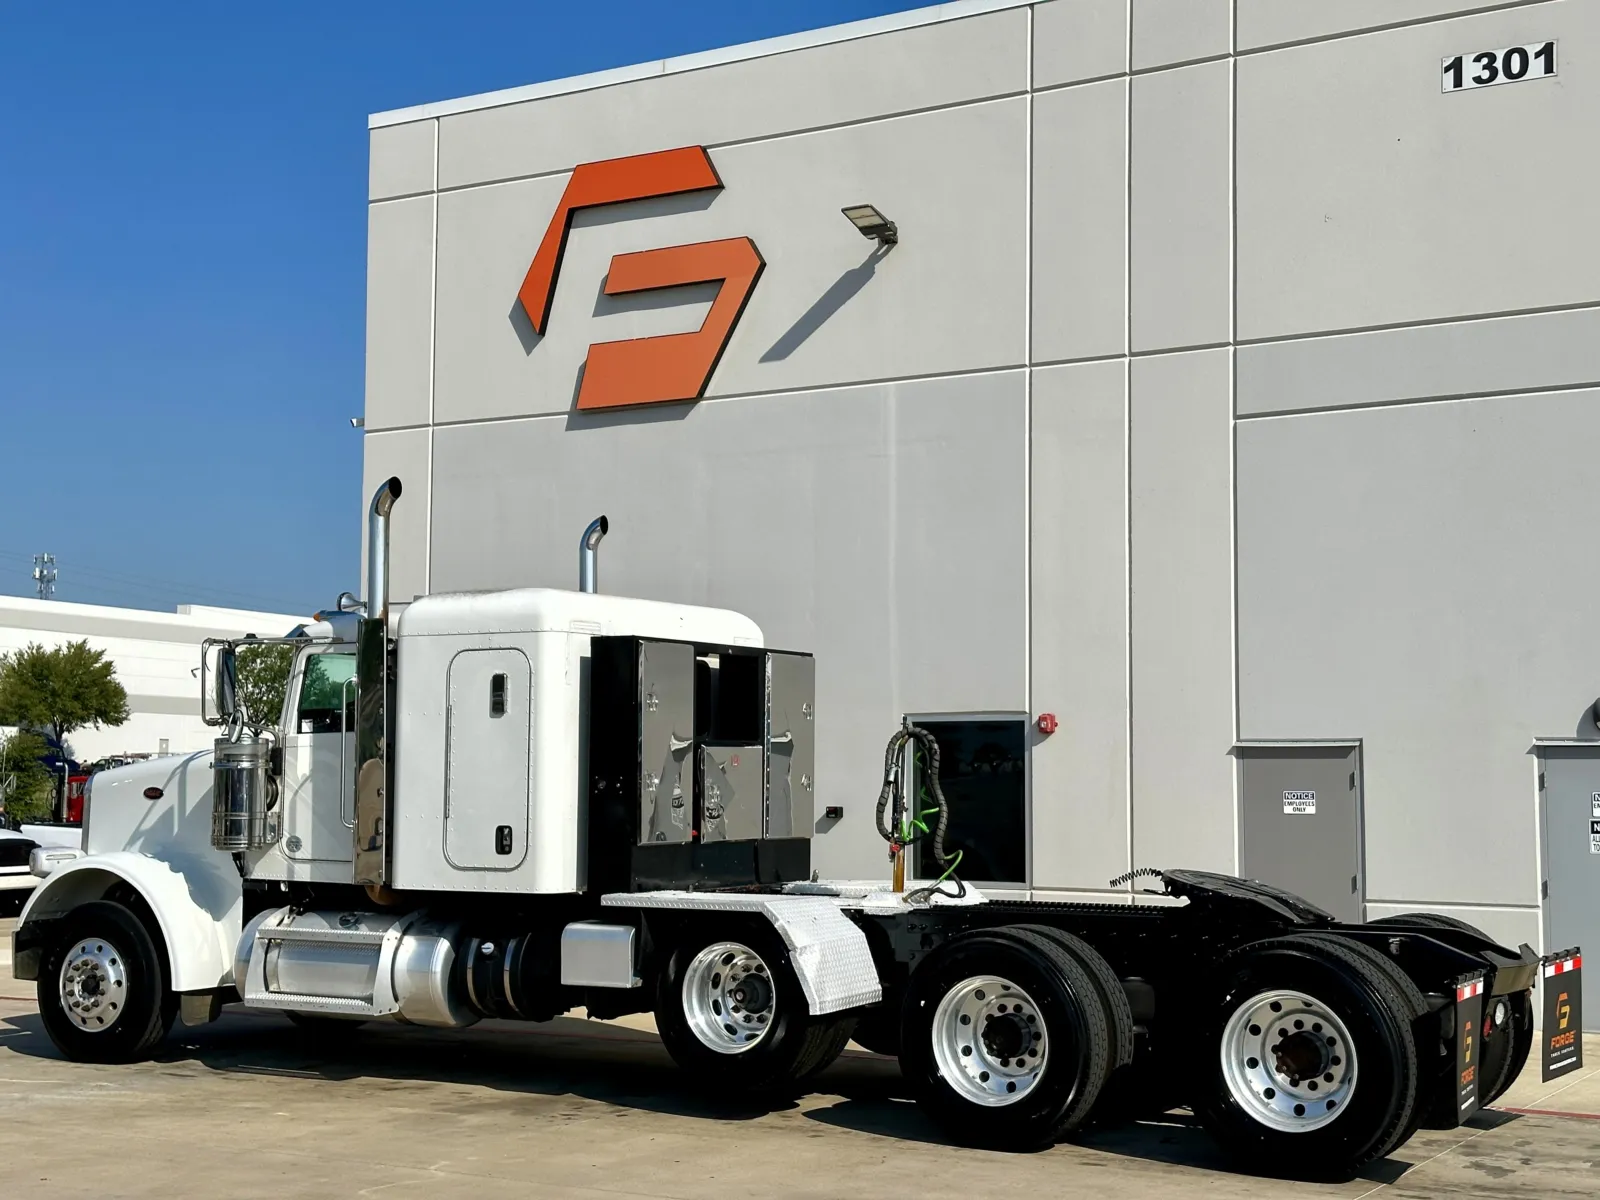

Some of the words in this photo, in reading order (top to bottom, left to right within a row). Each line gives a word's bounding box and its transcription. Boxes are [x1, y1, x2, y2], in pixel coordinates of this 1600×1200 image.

[1443, 41, 1555, 89] 1301
[1285, 792, 1314, 800] NOTICE
[1550, 1030, 1576, 1050] FORGE
